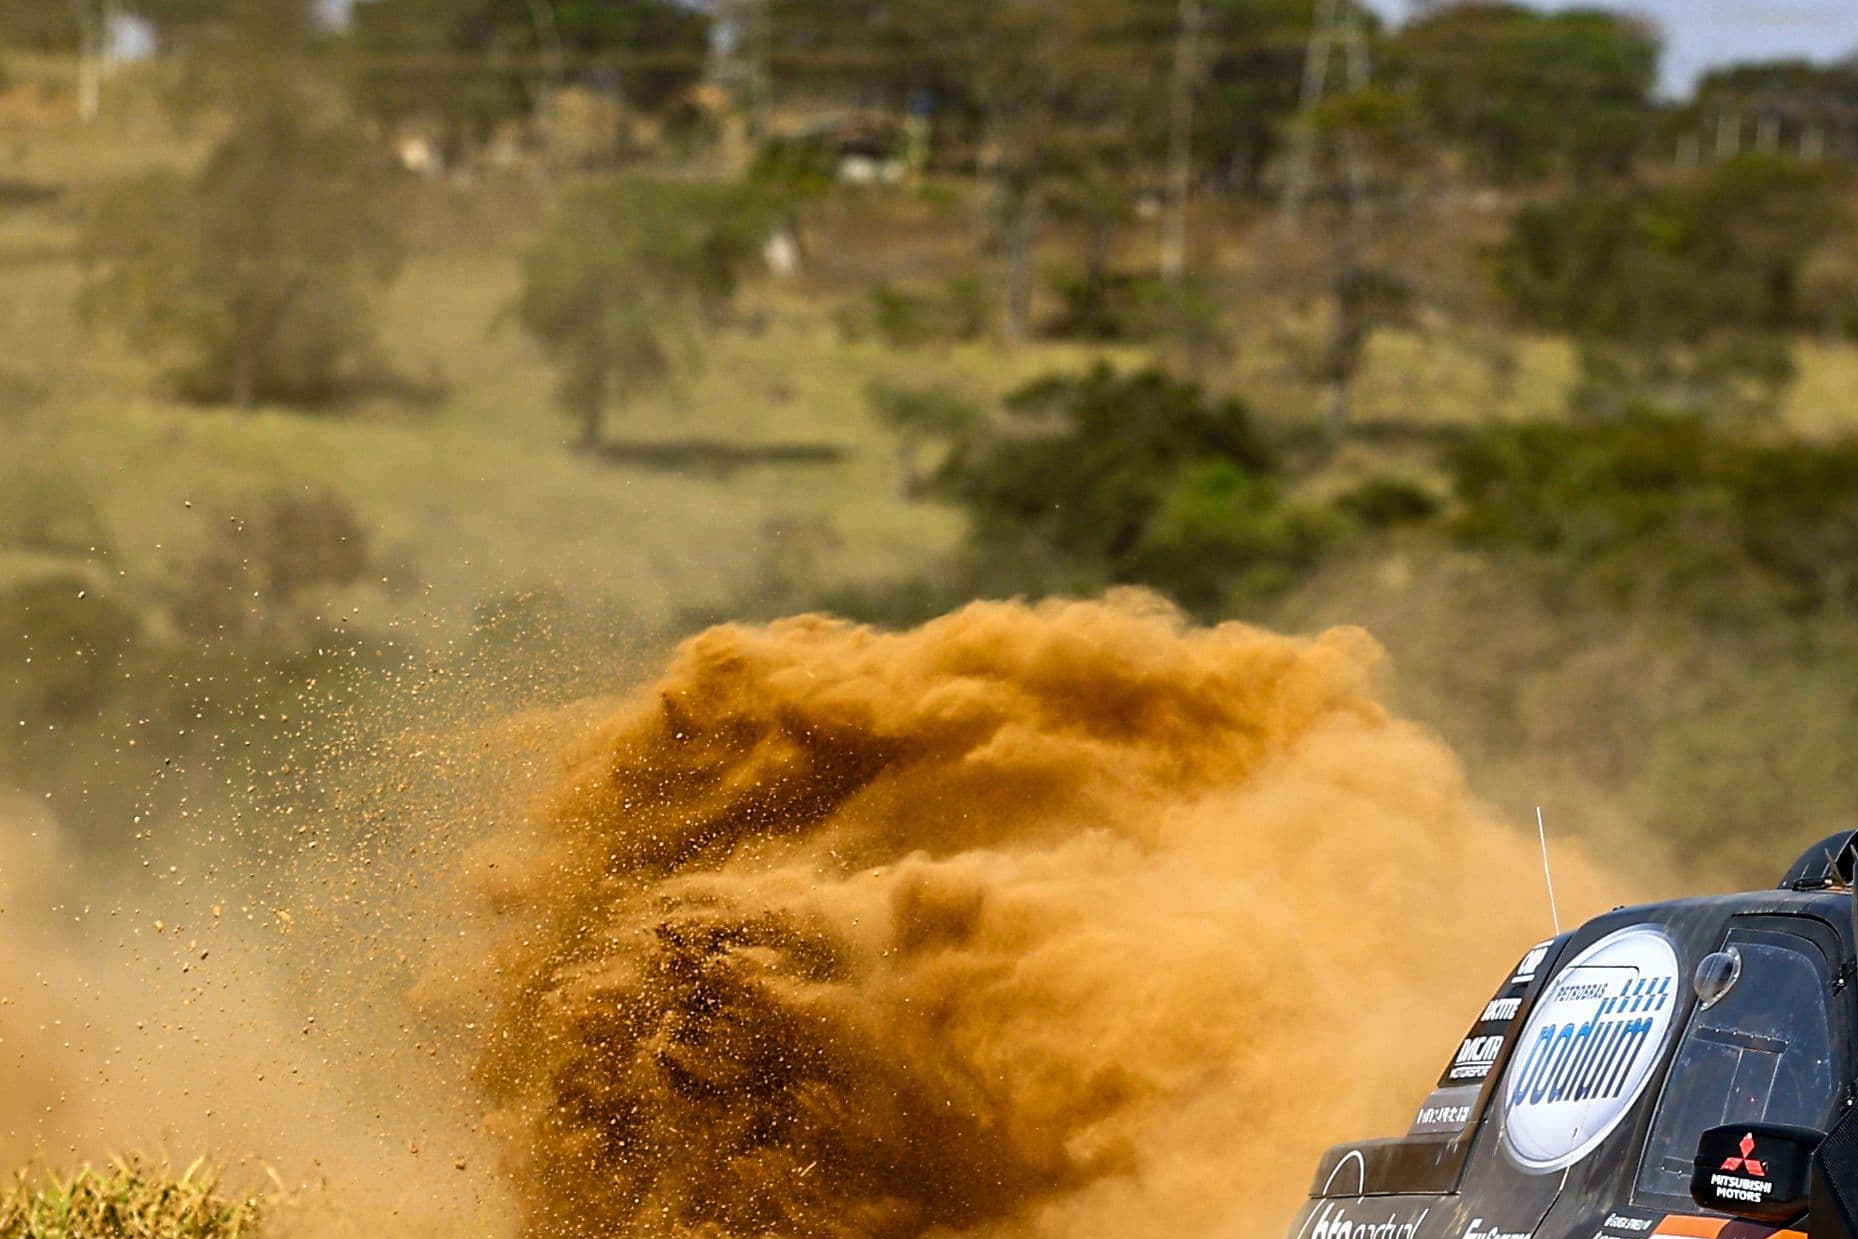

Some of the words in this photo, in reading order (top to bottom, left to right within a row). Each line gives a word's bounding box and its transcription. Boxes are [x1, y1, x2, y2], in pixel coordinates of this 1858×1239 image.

[1555, 983, 1609, 1001] PETROBRAS
[1512, 995, 1654, 1106] podium
[1711, 1173, 1773, 1193] MITSUBISHI
[1716, 1186, 1762, 1203] MOTORS
